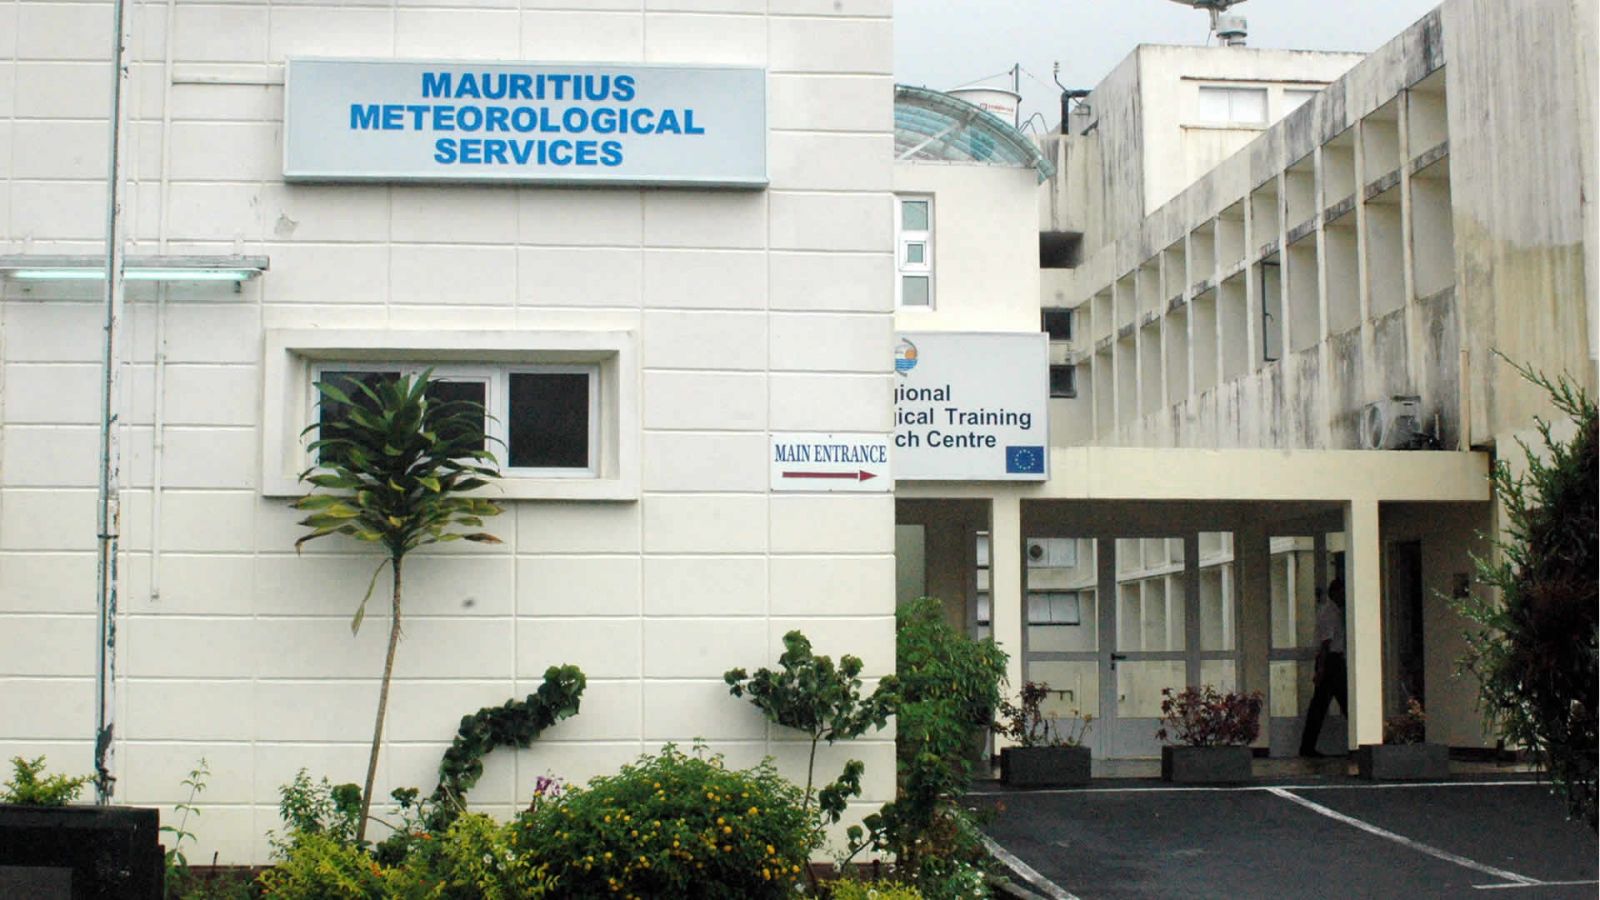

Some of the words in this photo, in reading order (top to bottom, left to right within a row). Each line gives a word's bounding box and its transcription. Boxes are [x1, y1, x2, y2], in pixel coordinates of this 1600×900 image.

[421, 71, 636, 102] MAURITIUS
[350, 103, 706, 135] METEOROLOGICAL
[433, 137, 623, 167] SERVICES
[895, 383, 951, 404] ional
[944, 408, 1032, 430] Training
[926, 430, 997, 448] Centre
[775, 444, 811, 463] MAIN
[814, 444, 888, 463] ENTRANCE
